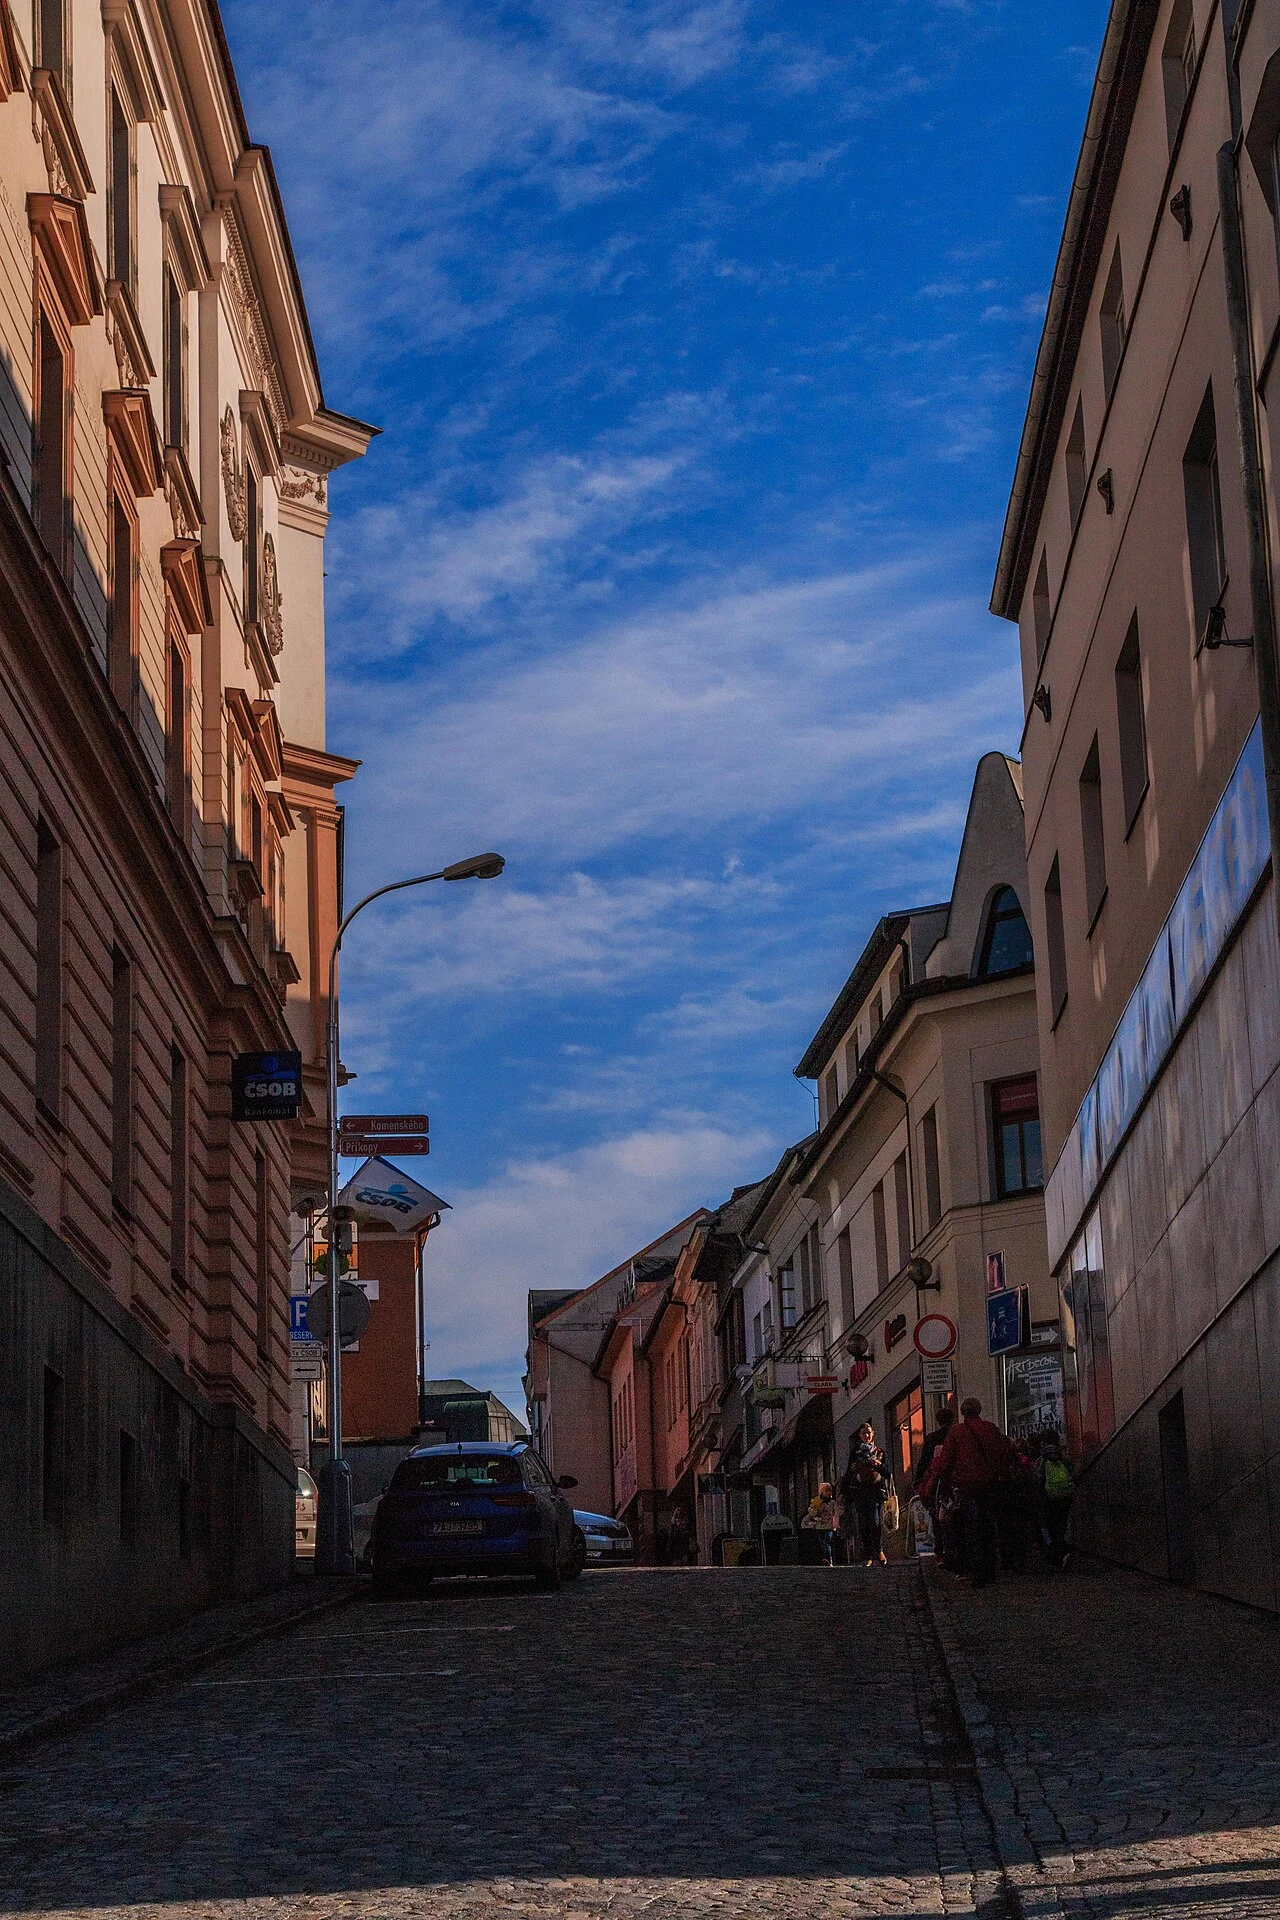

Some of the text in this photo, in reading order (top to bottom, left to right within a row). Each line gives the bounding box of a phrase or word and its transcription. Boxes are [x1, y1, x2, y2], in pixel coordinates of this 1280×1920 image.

[244, 1082, 296, 1098] ČSOB
[244, 1107, 291, 1116] Bankomat
[371, 1120, 424, 1131] Komenského
[345, 1141, 378, 1153] Příkopy
[355, 1190, 412, 1214] ČSOB
[295, 1300, 309, 1327] P
